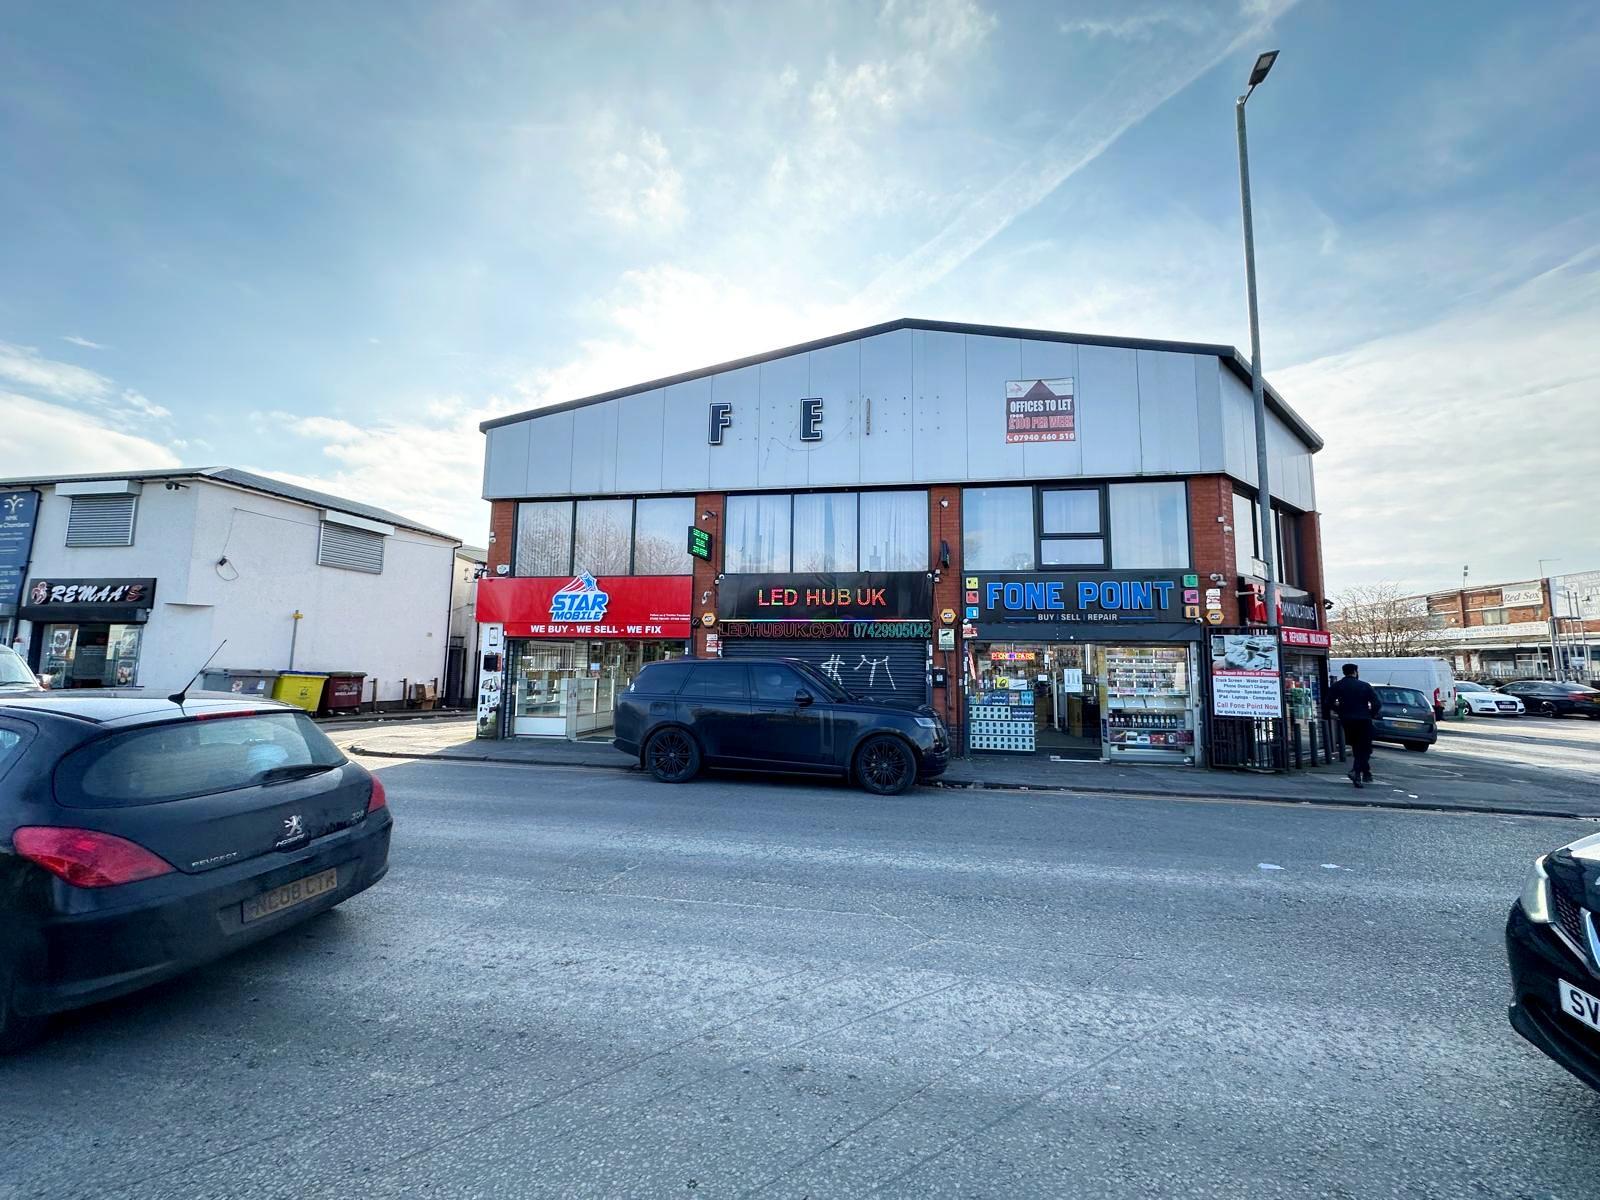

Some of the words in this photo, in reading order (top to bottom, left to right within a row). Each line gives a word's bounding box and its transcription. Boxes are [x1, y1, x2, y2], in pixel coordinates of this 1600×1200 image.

[1009, 400, 1044, 413] OFFICES
[1045, 399, 1056, 412] TO
[1057, 398, 1073, 411] LET
[708, 402, 732, 445] F
[799, 397, 823, 441] E
[1031, 415, 1049, 429] PER
[1048, 414, 1074, 428] WEEK
[1041, 433, 1057, 441] 460
[50, 584, 144, 603] REMAA'S
[758, 588, 798, 606] LED
[806, 588, 852, 606] HUB
[856, 587, 887, 606] UK
[986, 581, 1065, 610] FONE
[1077, 580, 1175, 610] POINT
[1503, 593, 1521, 602] Red
[1522, 591, 1541, 600] Sox
[552, 593, 606, 611] STAR
[553, 611, 602, 621] MOBILE
[1037, 613, 1055, 621] BUY
[1061, 613, 1081, 621] SELL
[1087, 613, 1118, 621] REPAIR
[530, 625, 546, 634] WE
[547, 625, 569, 634] BUY
[576, 625, 593, 634] WE
[594, 625, 618, 634] SELL
[626, 625, 643, 634] WE
[644, 625, 662, 634] FIX
[718, 622, 849, 638] LEDHUBUK.COM
[191, 852, 238, 867] PEUGEOT
